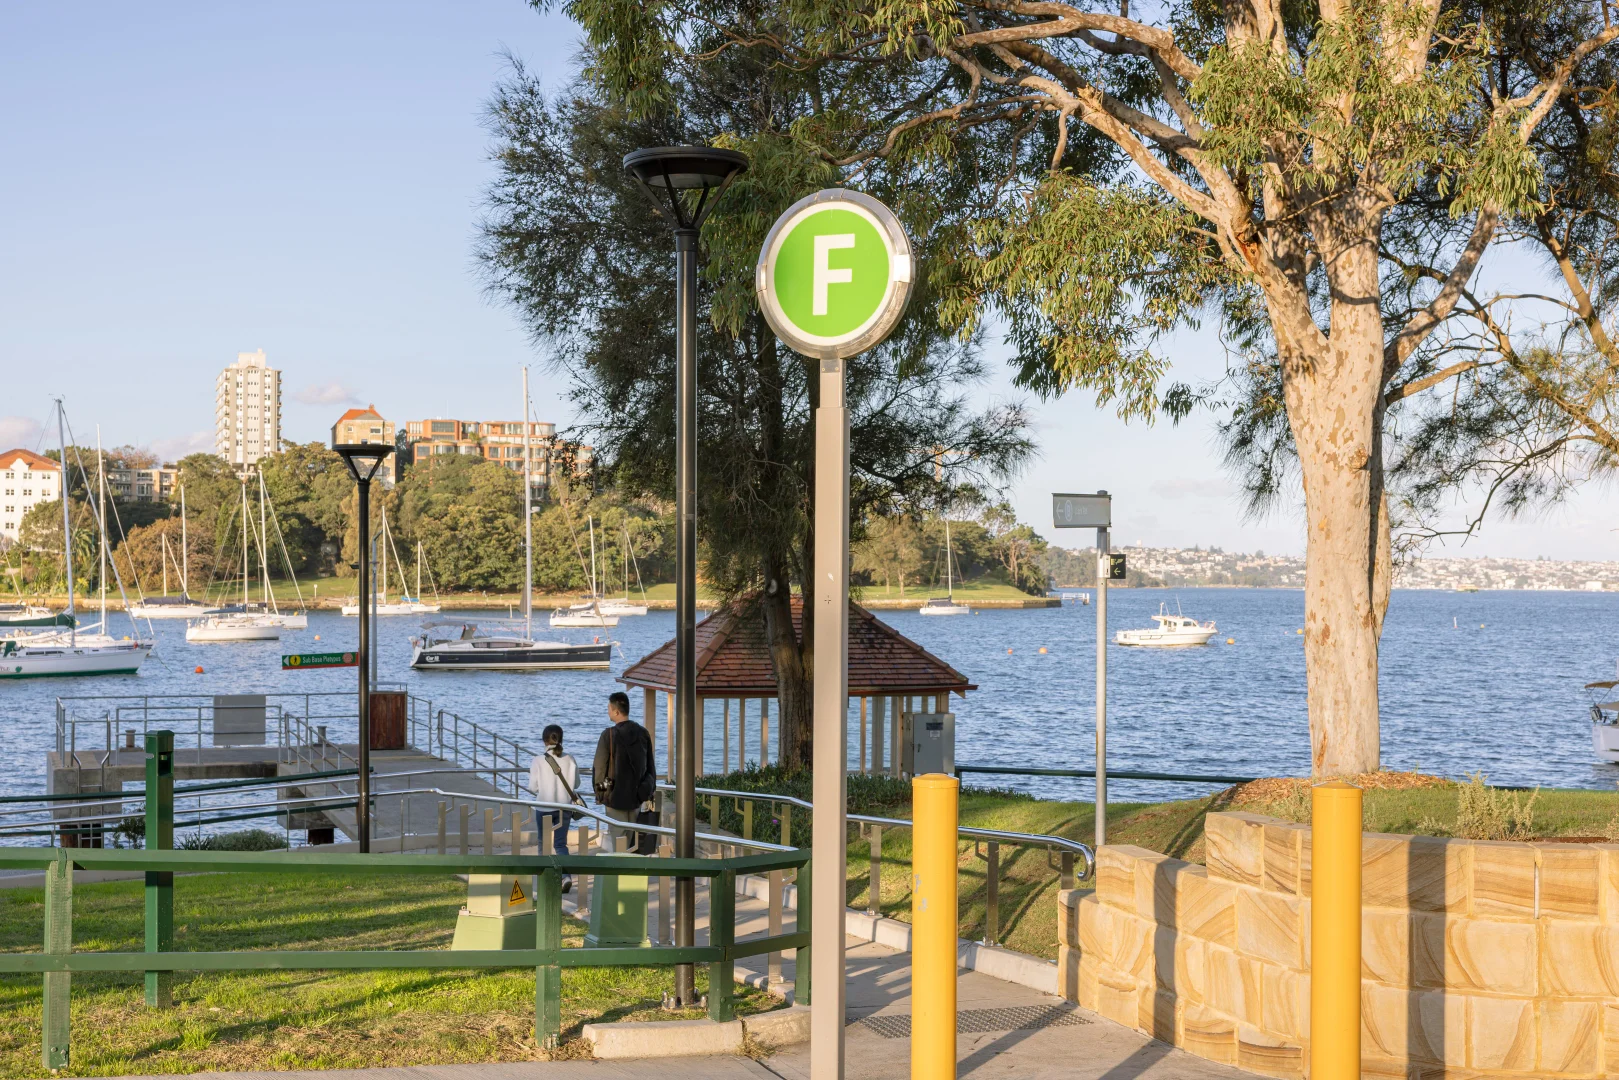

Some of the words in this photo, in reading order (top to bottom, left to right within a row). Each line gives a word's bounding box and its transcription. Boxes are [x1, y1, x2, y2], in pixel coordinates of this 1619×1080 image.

[812, 233, 856, 316] F
[302, 656, 311, 664] Sub
[311, 655, 322, 663] Base
[322, 655, 341, 663] Platypus
